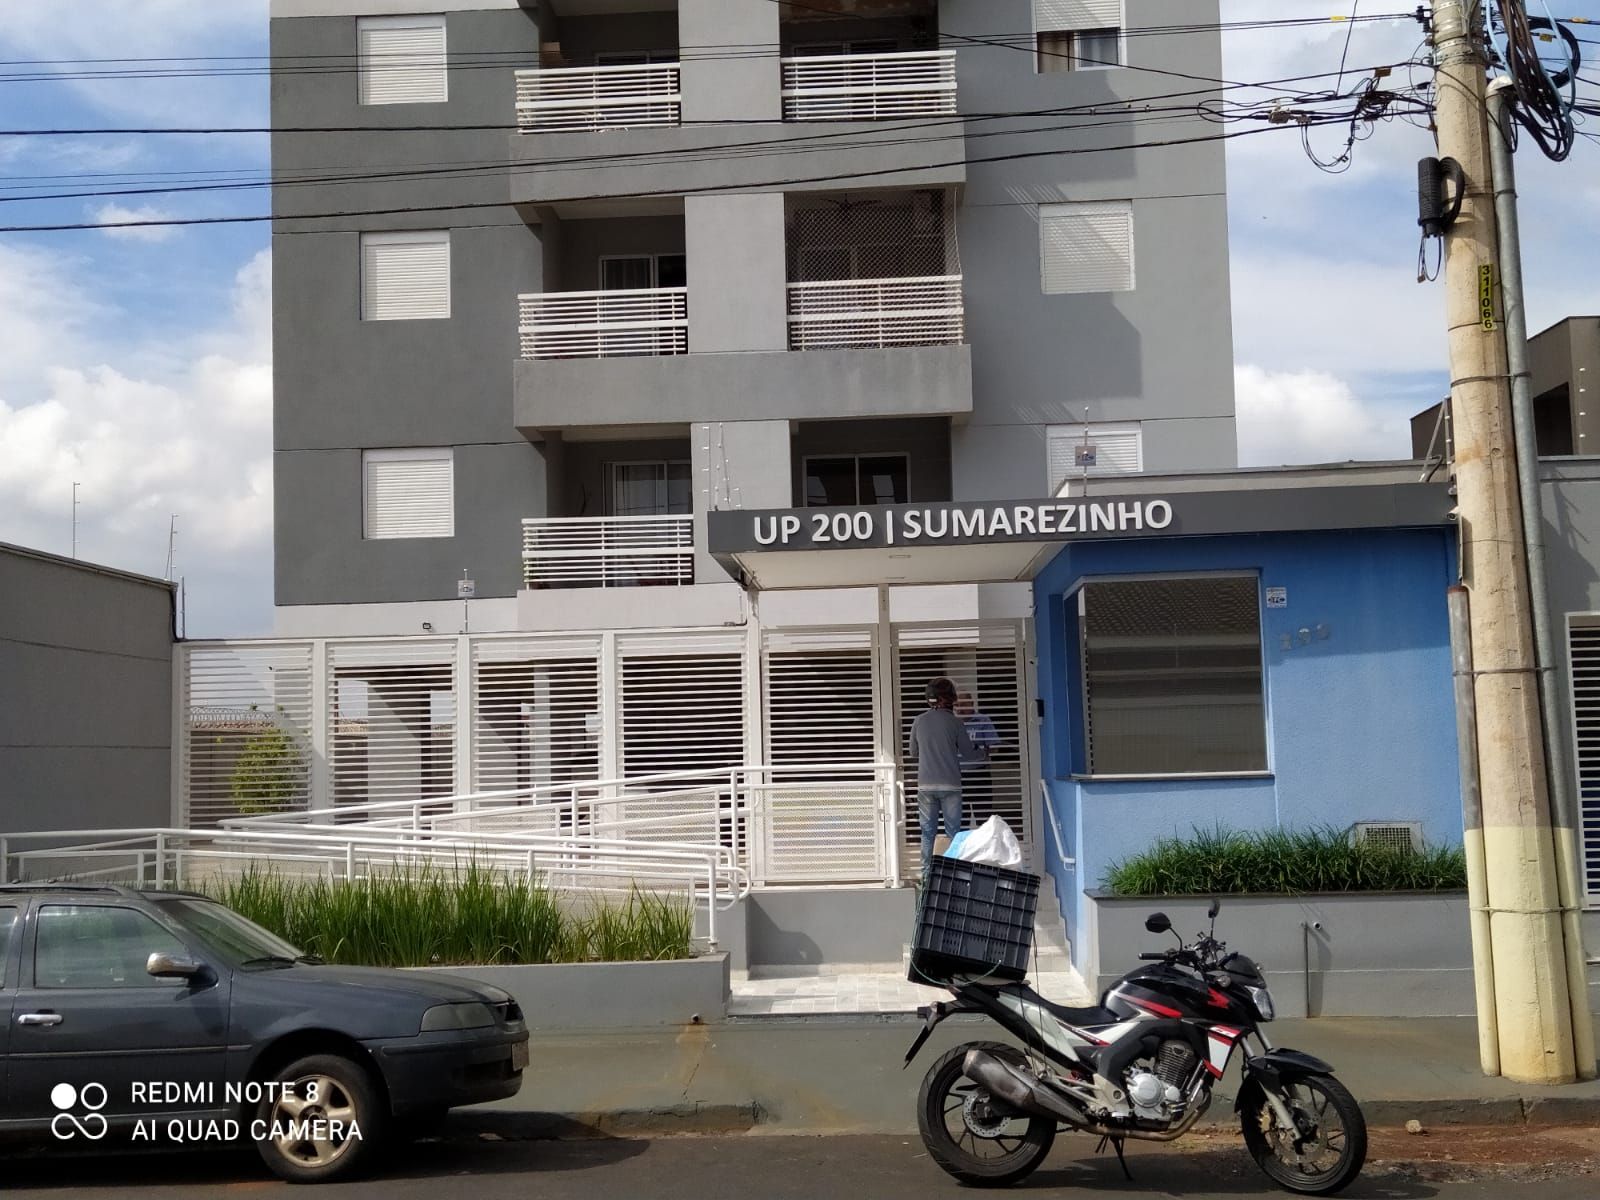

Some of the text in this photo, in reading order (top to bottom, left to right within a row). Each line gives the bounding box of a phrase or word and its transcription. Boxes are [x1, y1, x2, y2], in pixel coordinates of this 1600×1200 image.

[1481, 265, 1493, 329] 311066
[753, 515, 801, 545] UP
[811, 511, 874, 543] 200
[902, 499, 1174, 540] SUMAREZINHO
